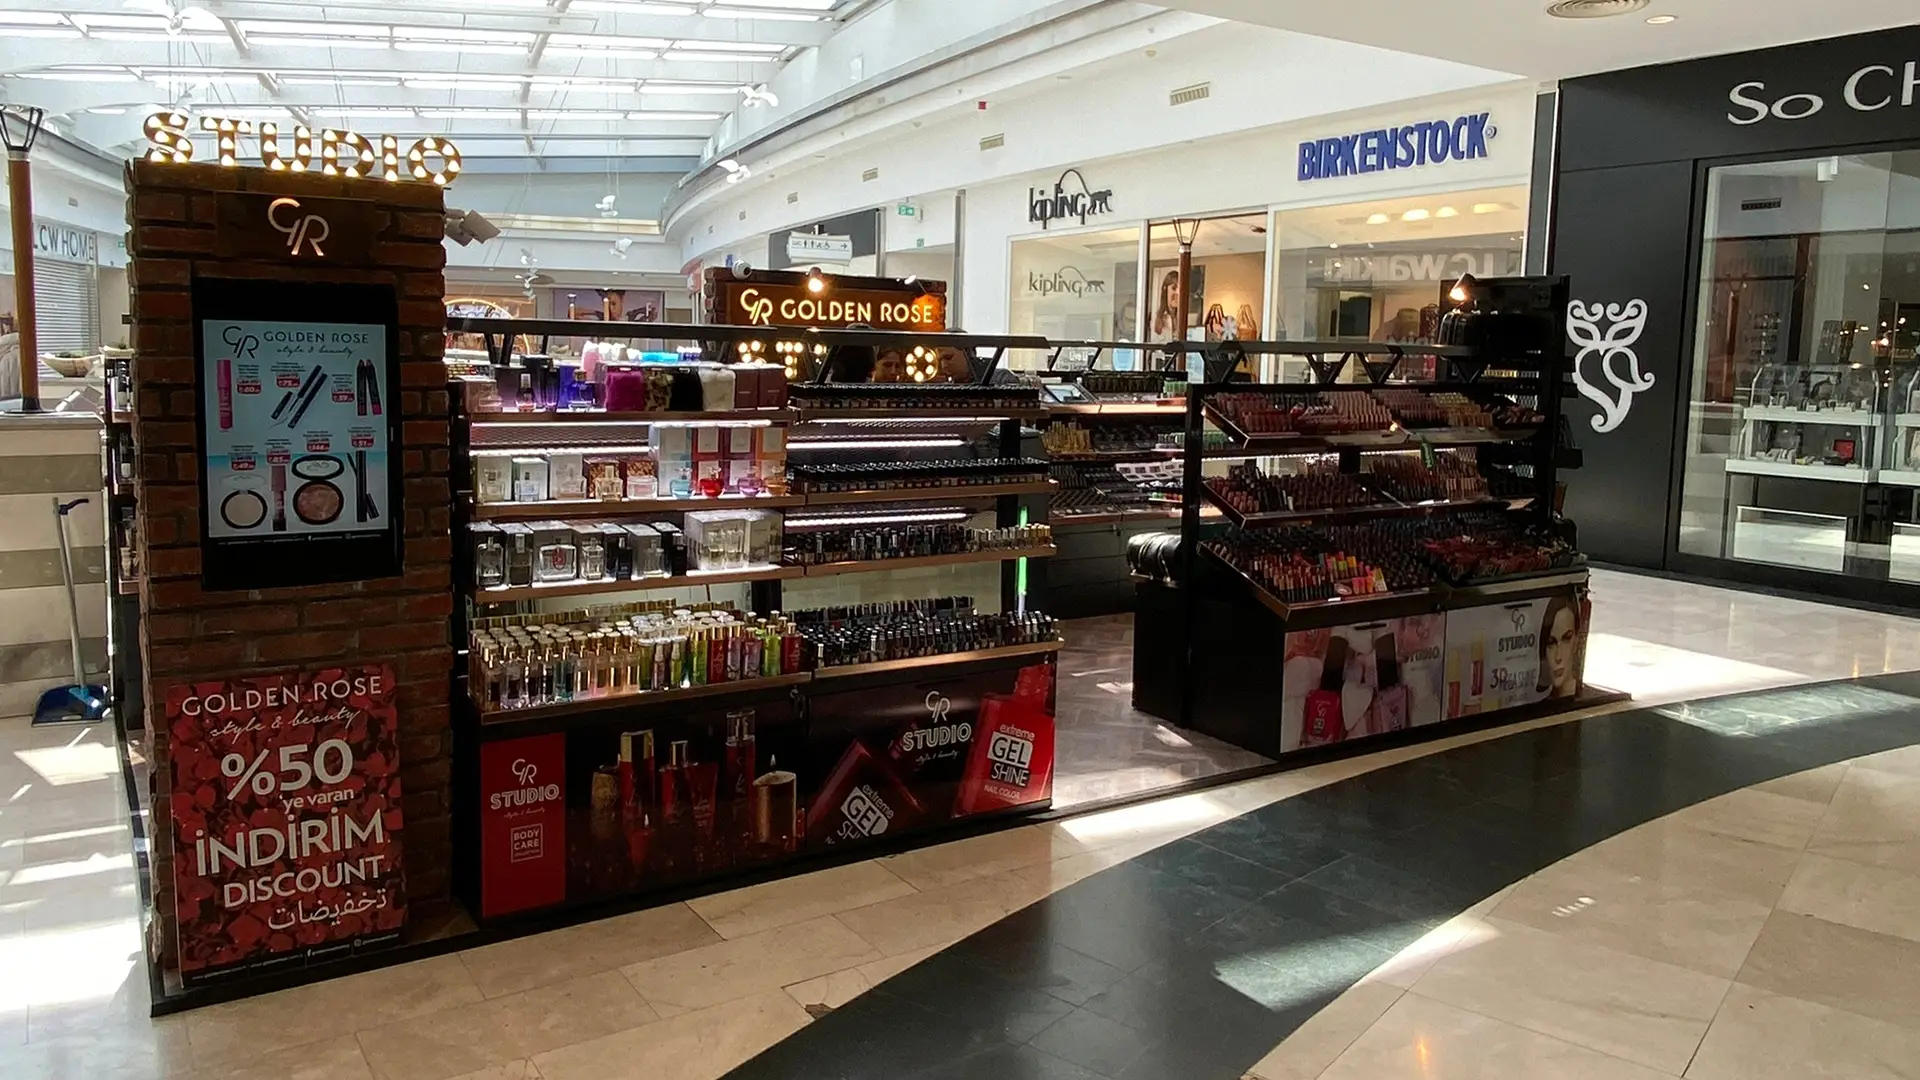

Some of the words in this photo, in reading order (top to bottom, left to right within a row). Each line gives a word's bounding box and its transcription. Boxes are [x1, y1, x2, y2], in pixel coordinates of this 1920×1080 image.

[1727, 81, 1824, 125] So
[143, 111, 461, 186] STUDIO
[1297, 112, 1490, 182] BIRKENSTOCK
[62, 229, 94, 260] HOME
[780, 298, 872, 322] GOLDEN
[880, 301, 933, 324] ROSE
[263, 331, 326, 344] GOLDEN
[331, 332, 369, 345] ROSE
[181, 686, 300, 716] GOLDEN
[313, 675, 383, 702] ROSE
[209, 718, 265, 744] style
[271, 713, 282, 730] &
[287, 707, 361, 730] beauty
[902, 722, 972, 752] STUDIO
[999, 723, 1035, 742] extreme
[991, 736, 1029, 766] GEL
[220, 738, 354, 800] %50
[991, 763, 1030, 787] SHINE
[307, 788, 355, 806] varan
[490, 783, 560, 810] STUDIO
[862, 784, 894, 820] extreme
[983, 784, 998, 794] NAIL
[999, 786, 1021, 799] COLOR
[847, 793, 879, 836] GEL
[513, 828, 540, 841] BODY
[513, 838, 540, 851] CARE
[223, 855, 385, 908] DISCOUNT
[268, 886, 388, 930] تخفيضات
